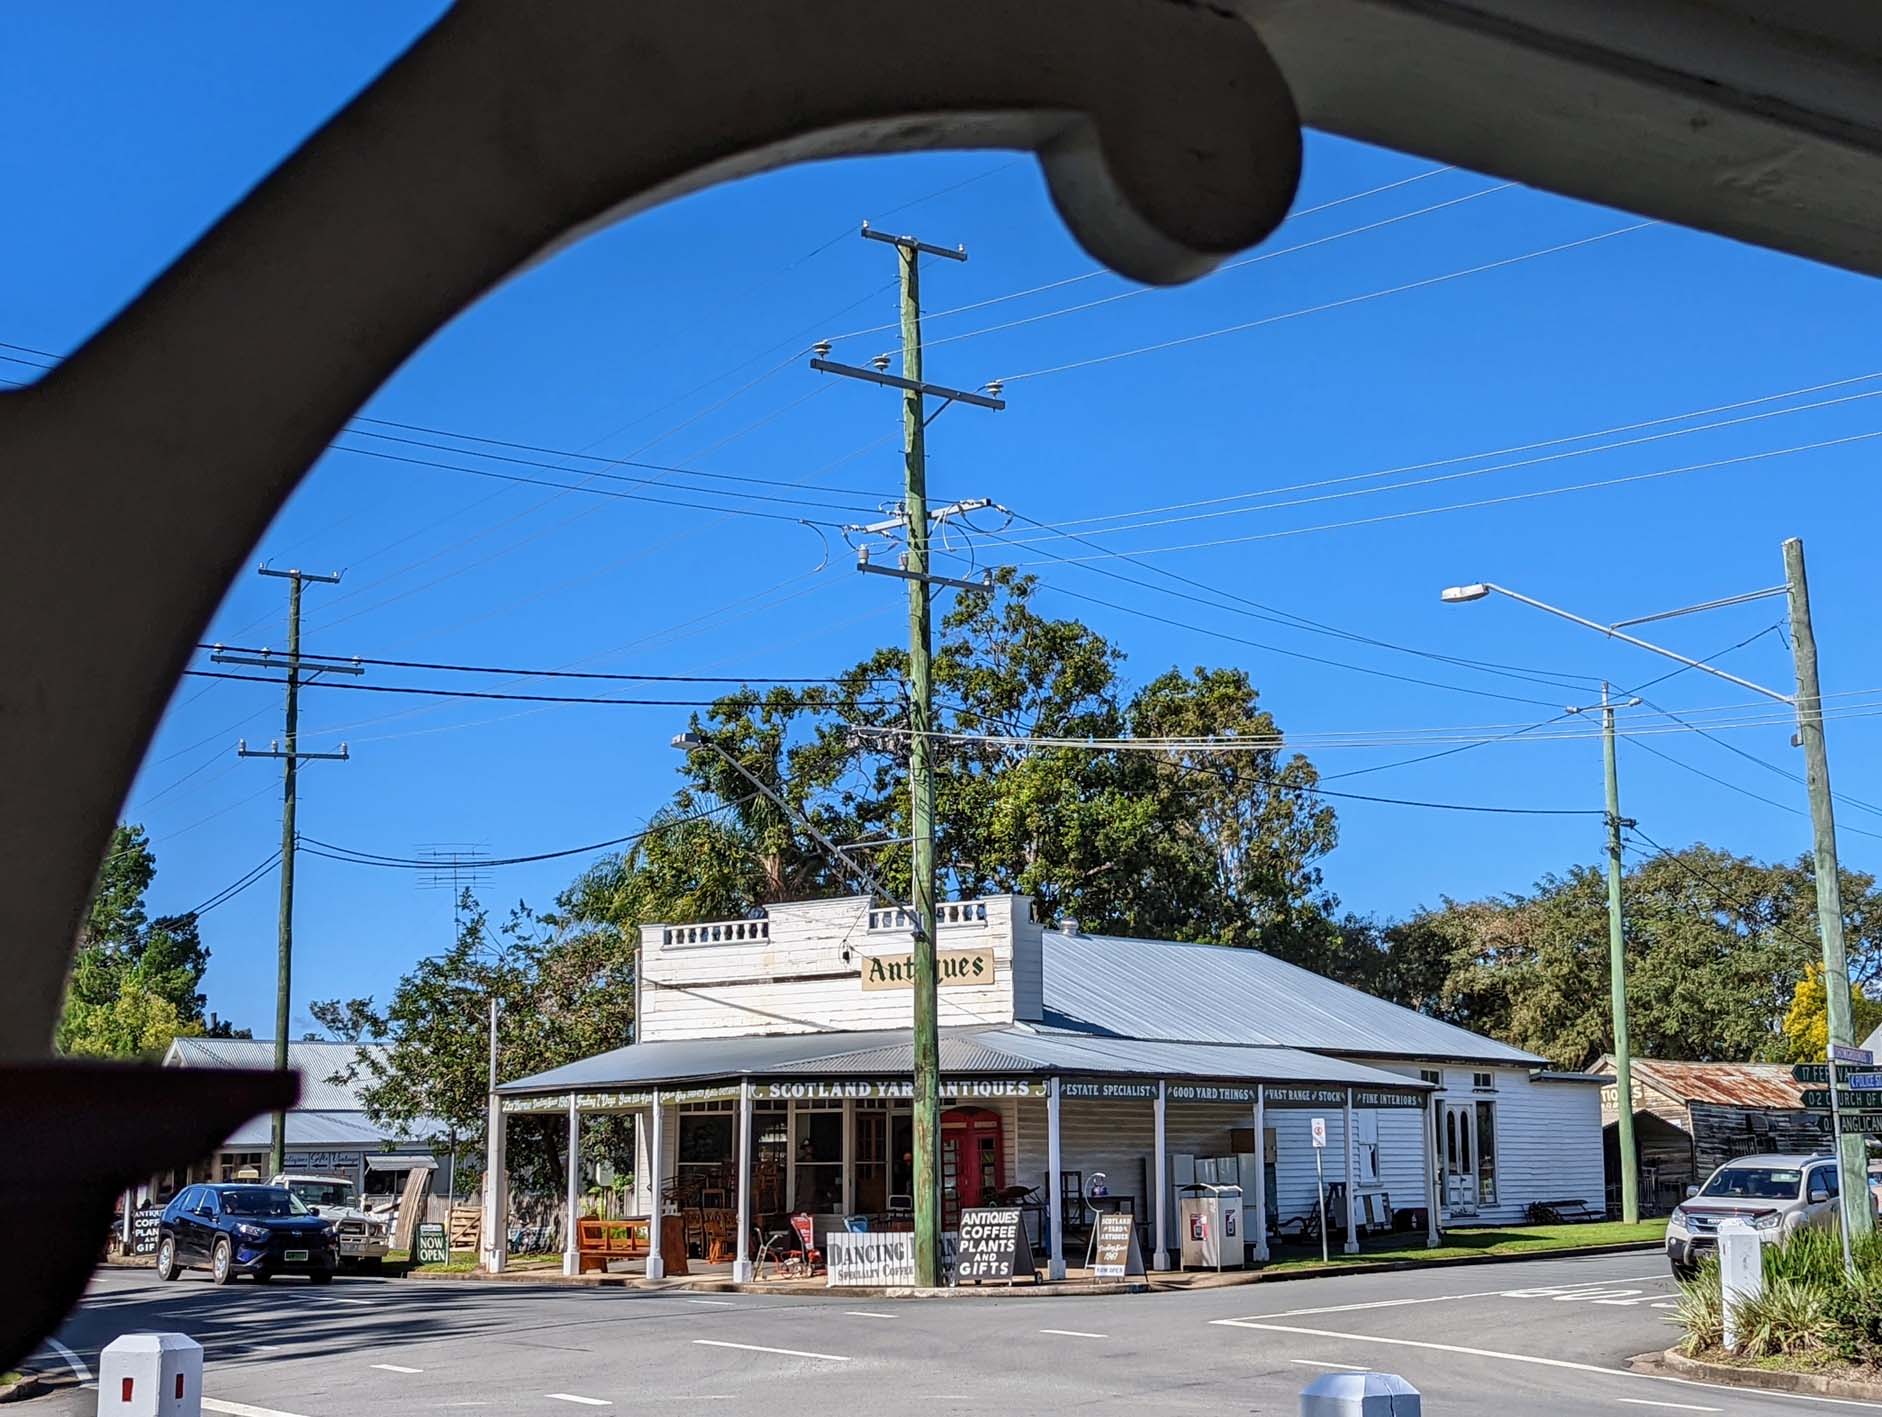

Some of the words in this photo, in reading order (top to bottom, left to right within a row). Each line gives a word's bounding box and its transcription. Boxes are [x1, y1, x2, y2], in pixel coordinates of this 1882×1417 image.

[869, 955, 985, 984] Antues
[769, 1082, 871, 1097] SCOTLAND
[877, 1082, 914, 1097] YAR
[1066, 1084, 1099, 1096] ESTATE
[1102, 1084, 1151, 1097] SPECIALIST
[1173, 1086, 1194, 1098] GOOD
[1196, 1087, 1218, 1099] YARD
[1219, 1088, 1249, 1100] THINGS
[1269, 1089, 1287, 1100] VAST
[1288, 1089, 1311, 1101] RANGE
[1318, 1091, 1341, 1102] STOCK
[1362, 1093, 1379, 1104] FINE
[1379, 1094, 1417, 1106] INTERIORS
[1826, 1092, 1862, 1106] CURCH
[135, 1219, 160, 1227] COFF
[962, 1211, 1019, 1226] ANTIQUES
[135, 1228, 159, 1237] PLAN
[962, 1226, 1015, 1239] COFFEE
[136, 1243, 155, 1252] GIF
[420, 1237, 443, 1248] NOW
[959, 1240, 1015, 1253] PLANTS
[420, 1249, 445, 1261] OPEN
[829, 1242, 904, 1267] DANCING
[974, 1253, 997, 1261] AND
[959, 1262, 1009, 1275] GIFTS
[1500, 1287, 1682, 1308] TOP
